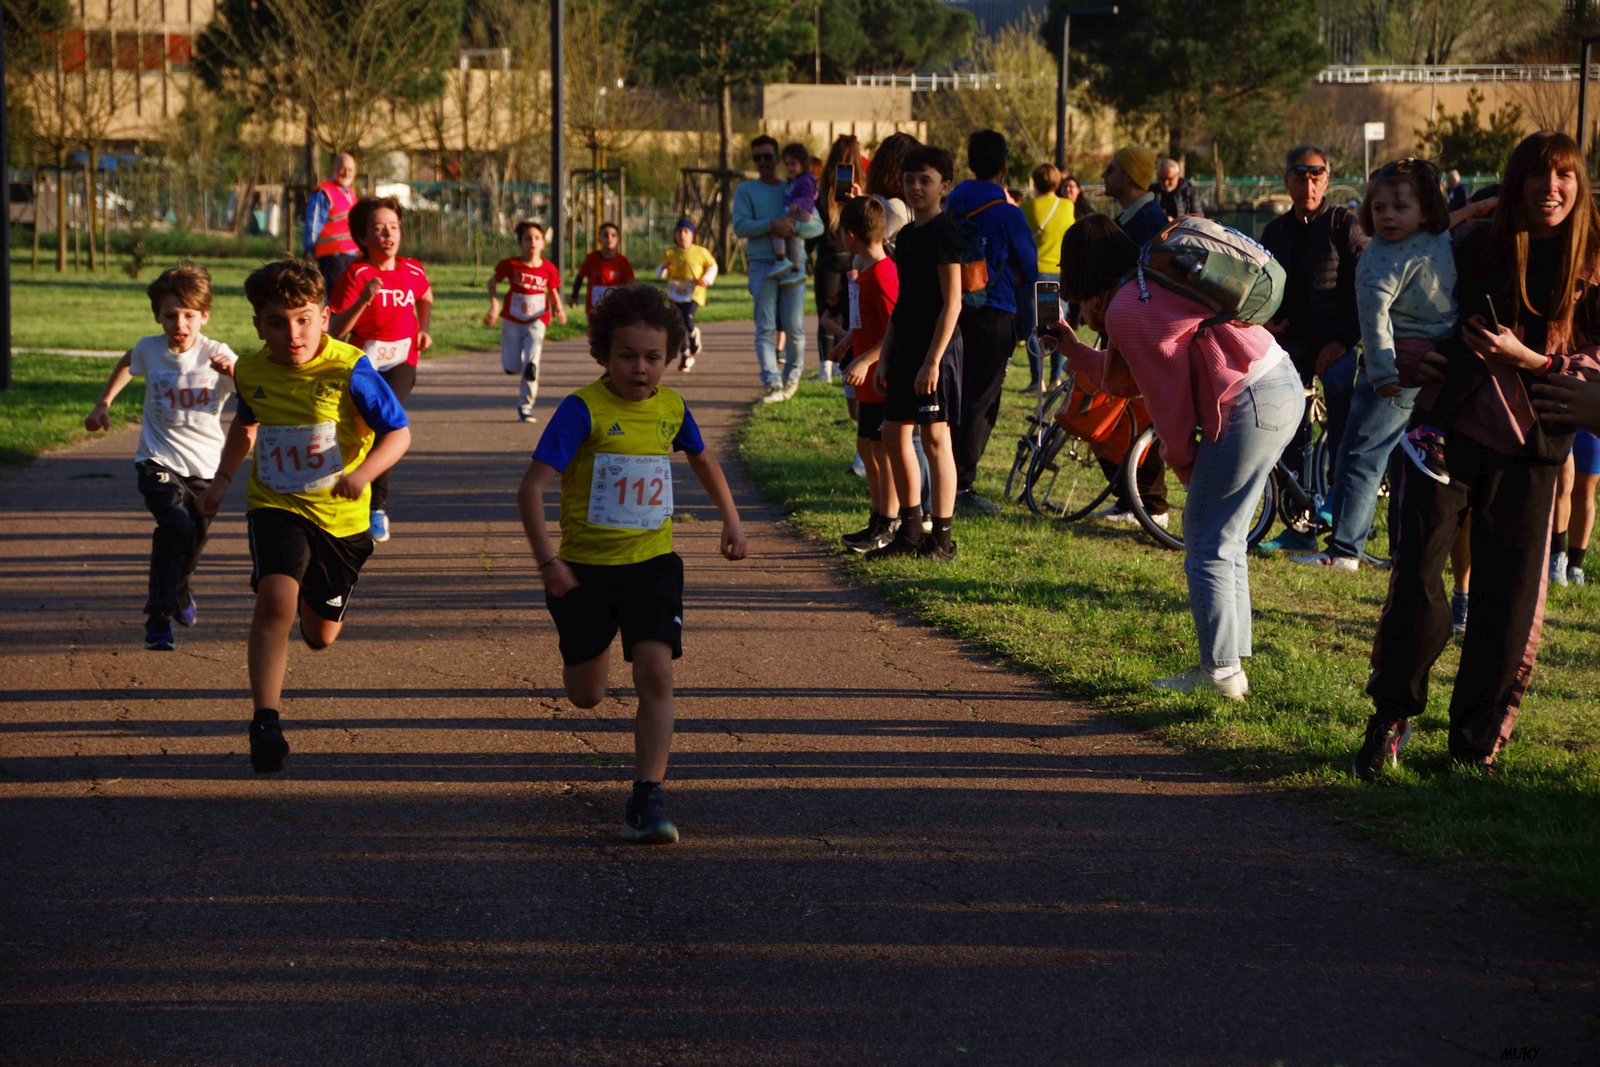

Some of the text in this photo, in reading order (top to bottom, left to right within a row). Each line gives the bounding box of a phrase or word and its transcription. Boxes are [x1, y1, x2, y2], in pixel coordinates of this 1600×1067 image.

[164, 386, 211, 410] 104
[270, 444, 325, 473] 115
[613, 476, 663, 506] 112
